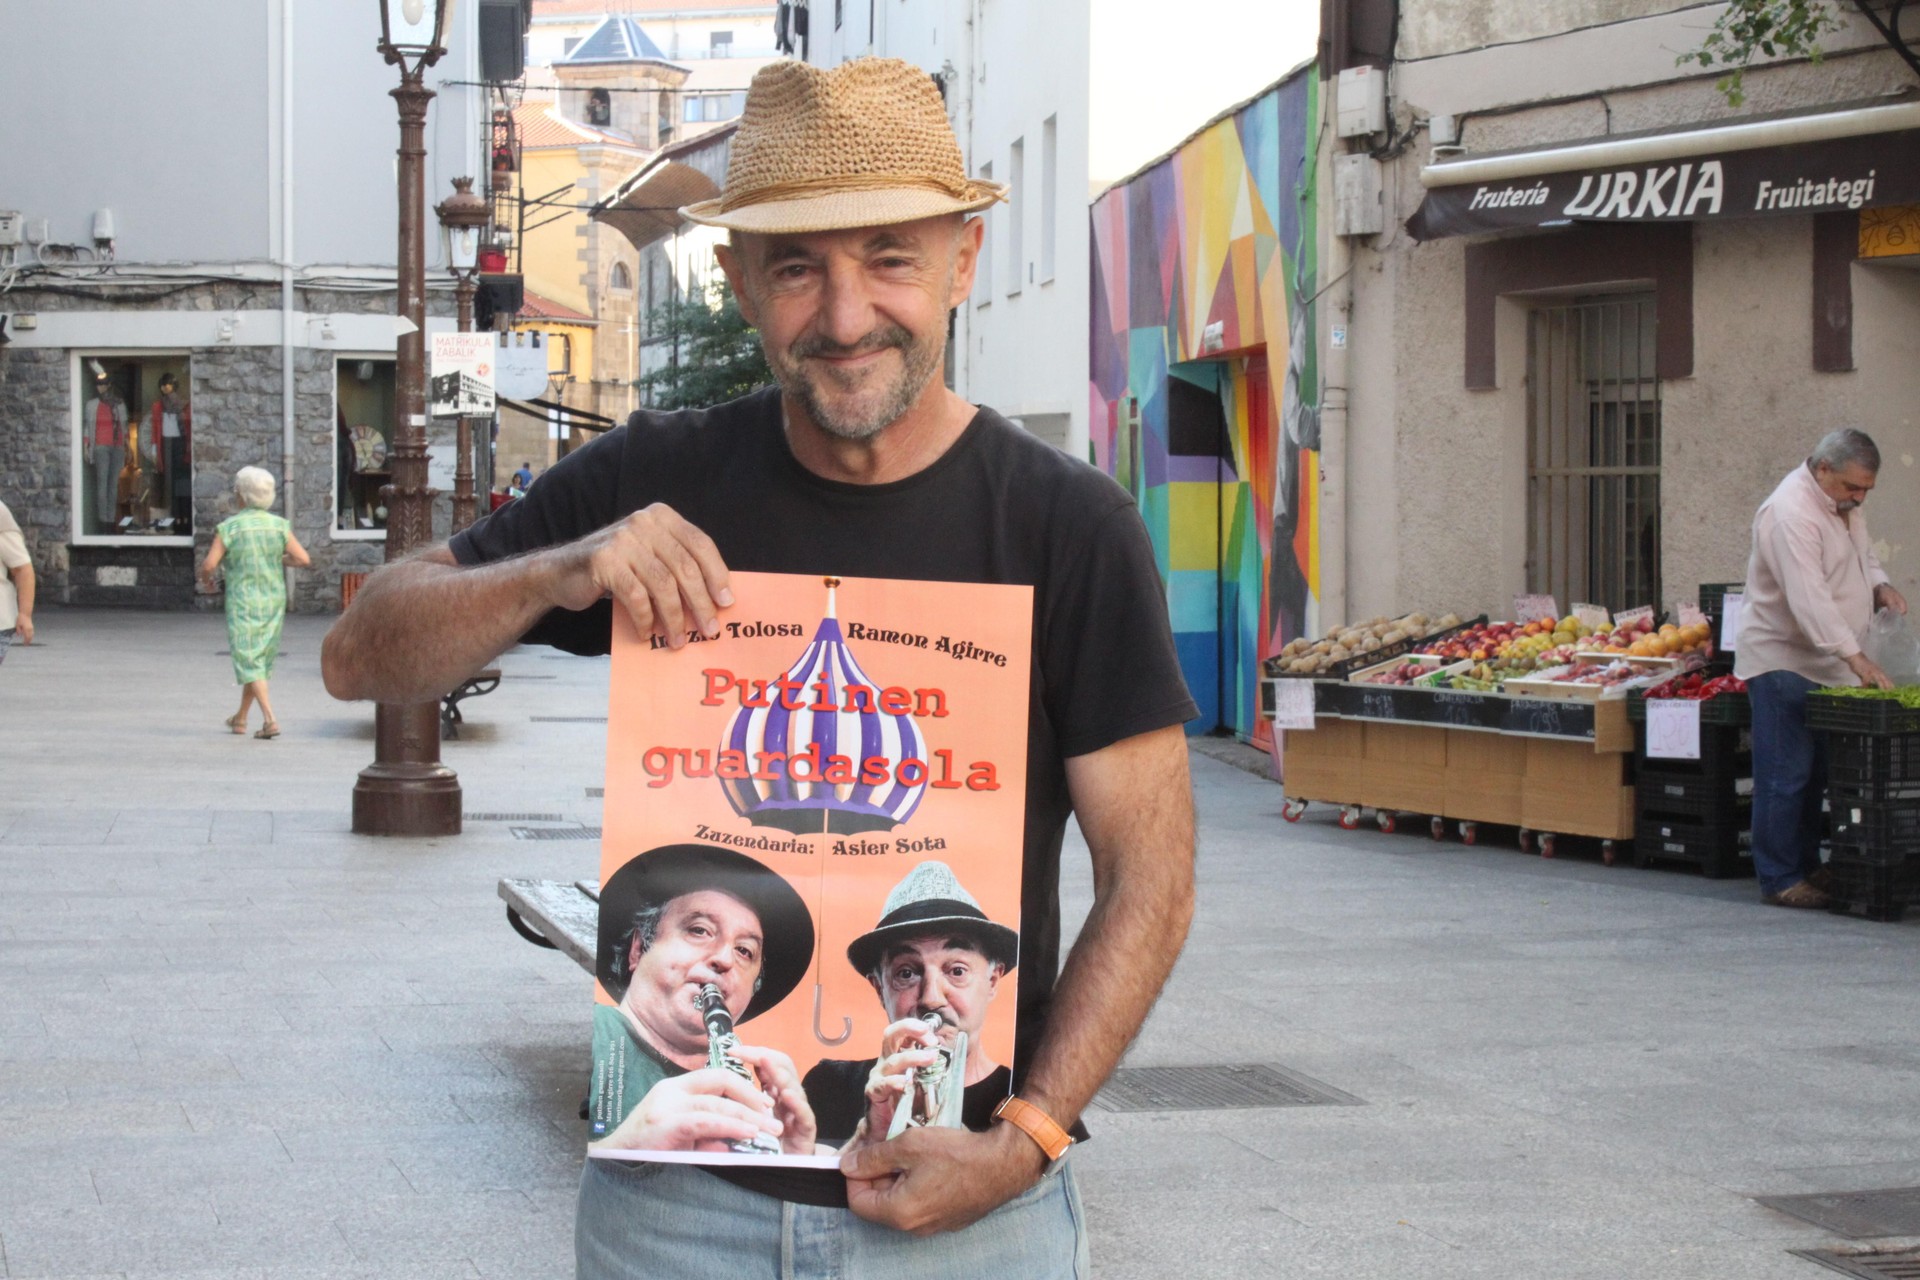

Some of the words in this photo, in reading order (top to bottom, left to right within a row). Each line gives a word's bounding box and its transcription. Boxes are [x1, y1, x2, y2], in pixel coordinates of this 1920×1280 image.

[1468, 180, 1550, 211] Frutería
[1562, 160, 1725, 218] URKIA
[1754, 169, 1876, 210] Fruitategi
[435, 337, 491, 347] MATRIKULA
[435, 348, 476, 357] ZABALIK
[725, 621, 804, 640] Tolosa
[847, 622, 929, 649] Ramon
[935, 635, 1008, 668] Agirre
[702, 667, 950, 718] Putinen
[642, 743, 1001, 791] guardasola
[694, 824, 815, 856] Zuzendaria:
[832, 839, 890, 856] Asier
[895, 834, 947, 853] Sota
